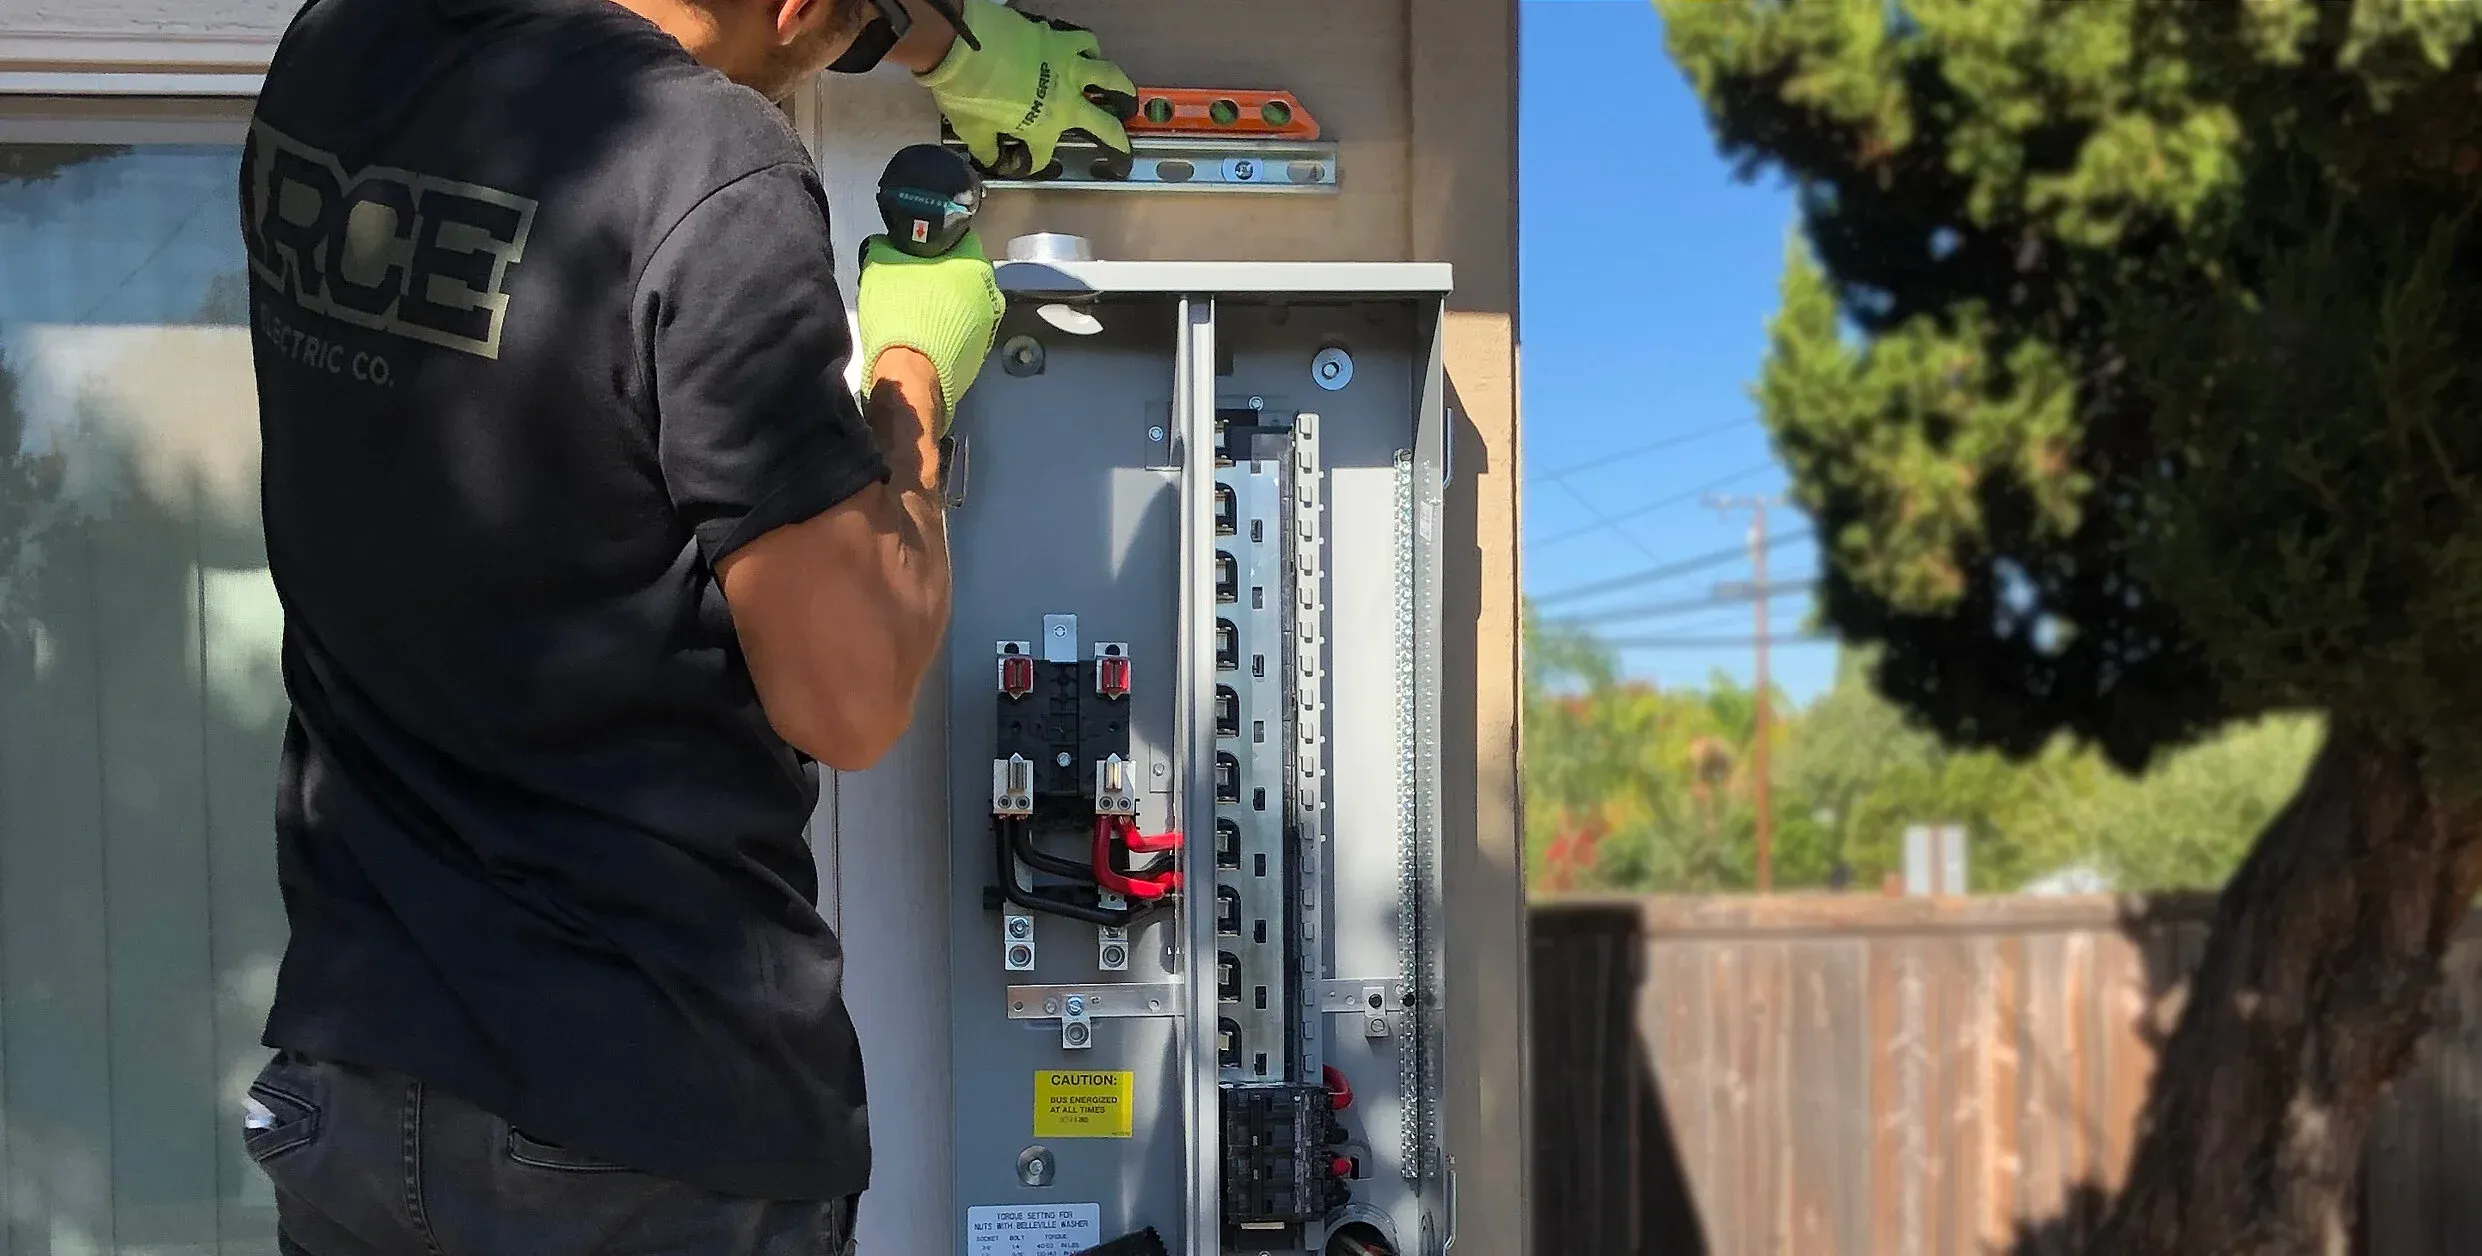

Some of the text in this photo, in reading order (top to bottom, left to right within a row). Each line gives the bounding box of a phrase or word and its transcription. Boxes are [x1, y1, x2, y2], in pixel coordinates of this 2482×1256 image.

[1036, 61, 1051, 99] GRIP
[353, 351, 395, 388] CO.
[1051, 1074, 1118, 1086] CAUTION:
[1050, 1096, 1118, 1104] BUS ENERGIZED
[1080, 1106, 1106, 1114] TIMES
[1027, 1211, 1056, 1220] SETTING
[1059, 1211, 1073, 1219] FOR
[974, 1222, 993, 1230] NUTS
[1061, 1220, 1089, 1228] WASHER
